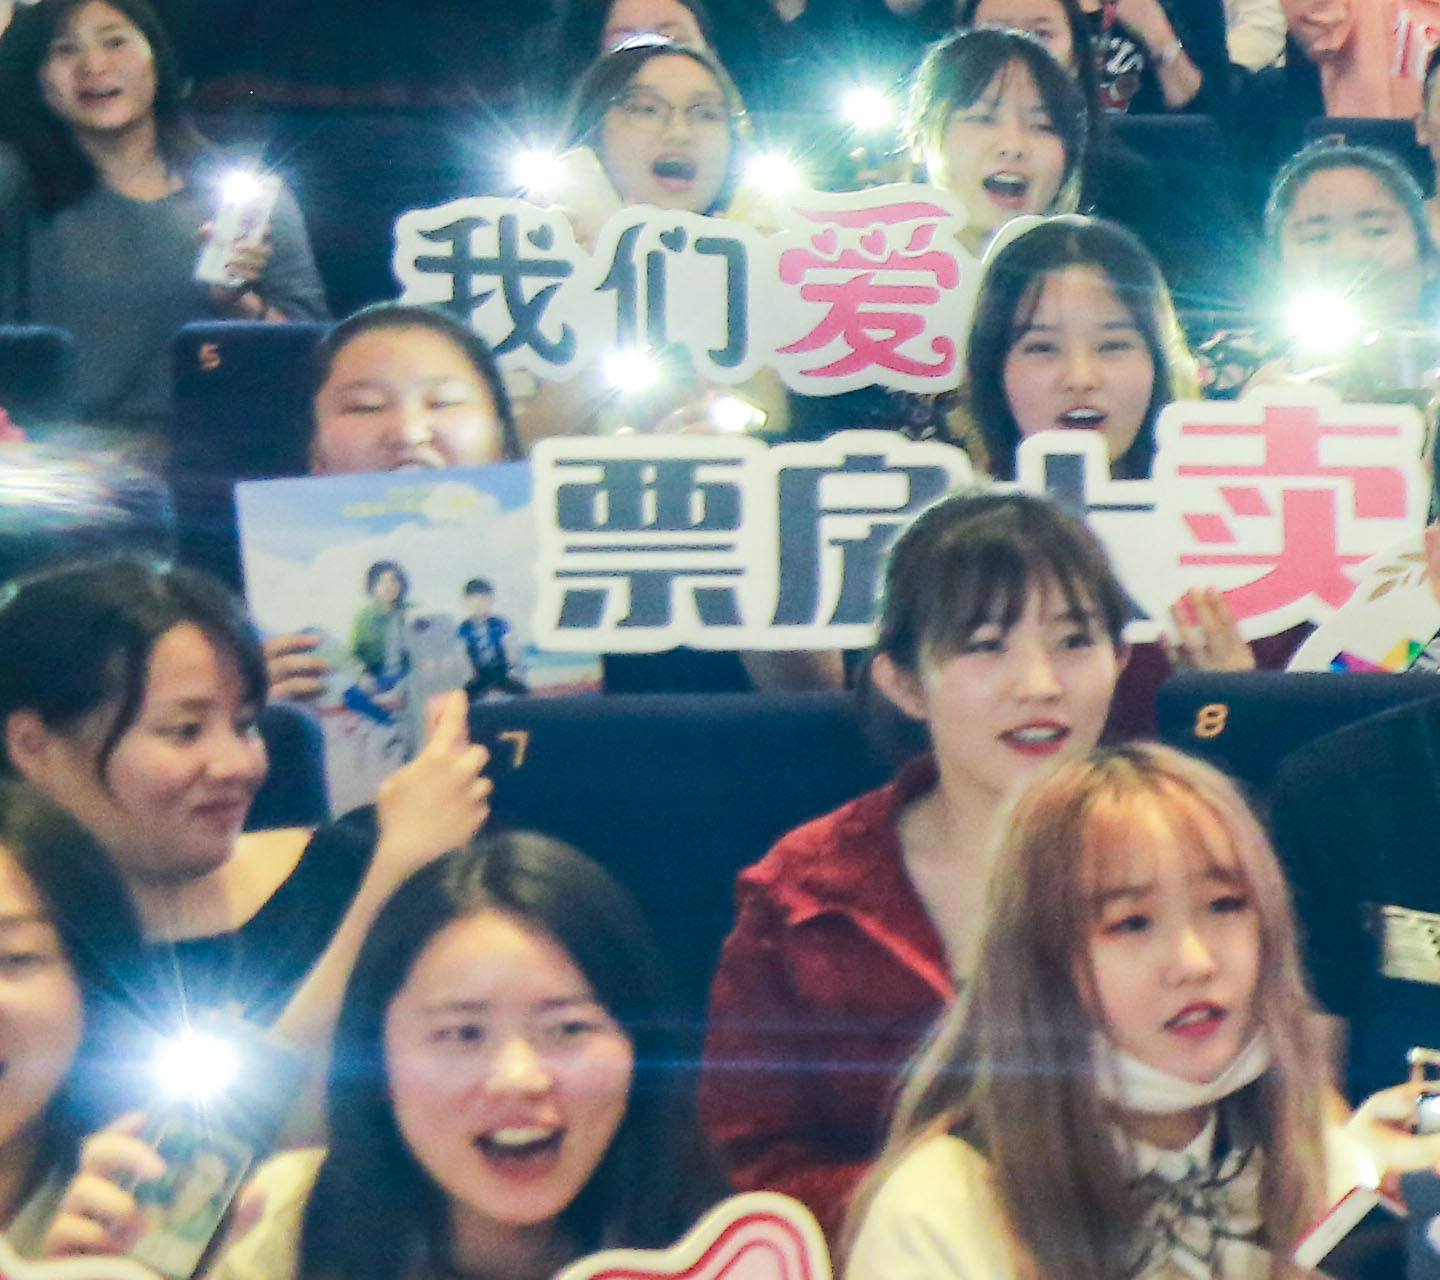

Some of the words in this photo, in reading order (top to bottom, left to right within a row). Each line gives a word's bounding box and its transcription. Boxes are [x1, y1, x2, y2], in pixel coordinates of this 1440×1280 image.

[199, 343, 221, 370] 5
[1195, 703, 1229, 738] 8
[499, 730, 529, 768] 7
